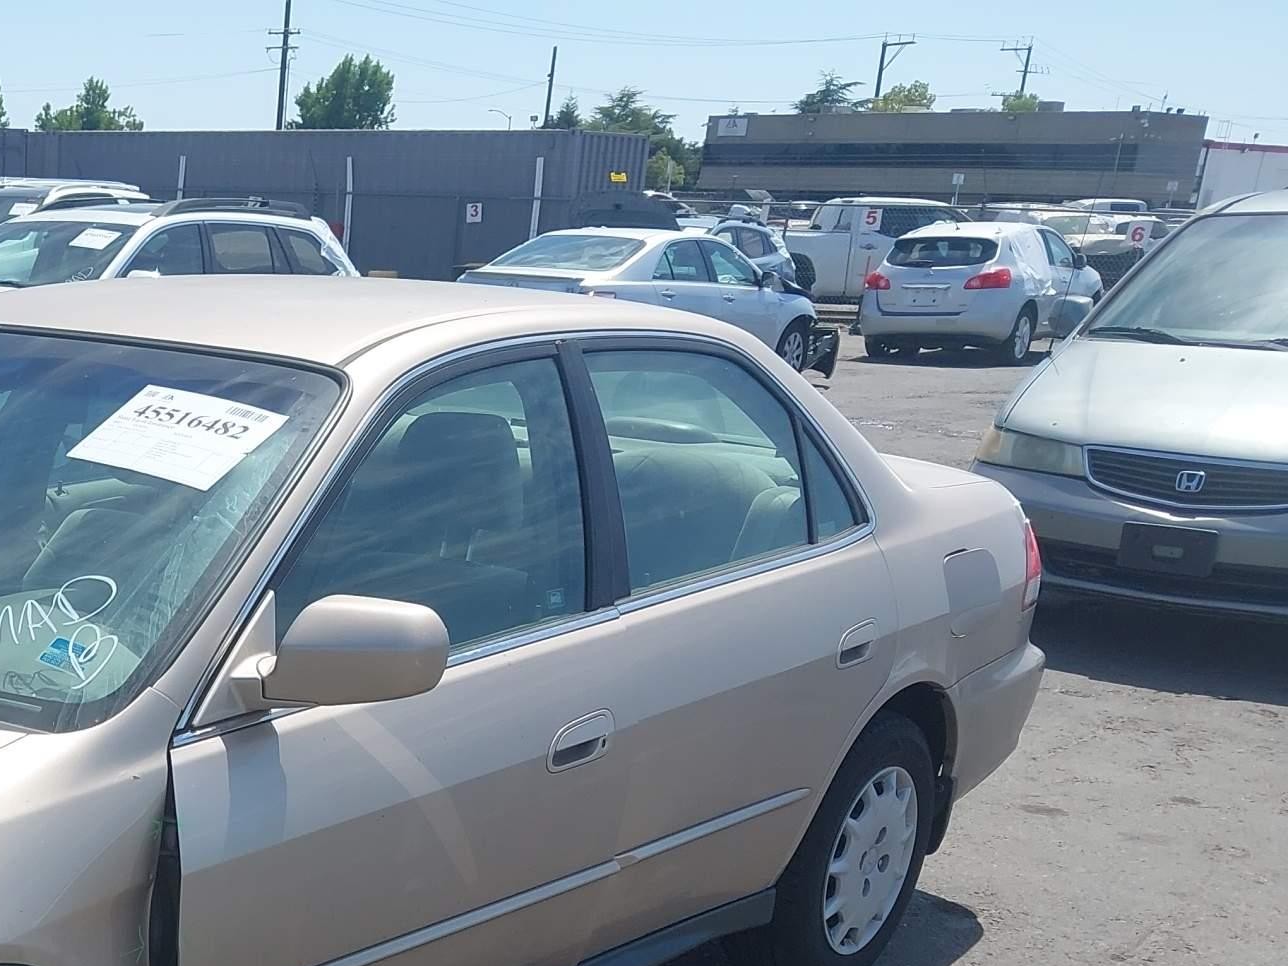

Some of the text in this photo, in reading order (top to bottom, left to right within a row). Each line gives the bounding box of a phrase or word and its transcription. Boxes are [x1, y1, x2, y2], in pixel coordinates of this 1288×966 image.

[470, 204, 479, 217] 3
[865, 210, 878, 225] 5
[1131, 226, 1145, 242] 6
[134, 404, 250, 440] 45516482
